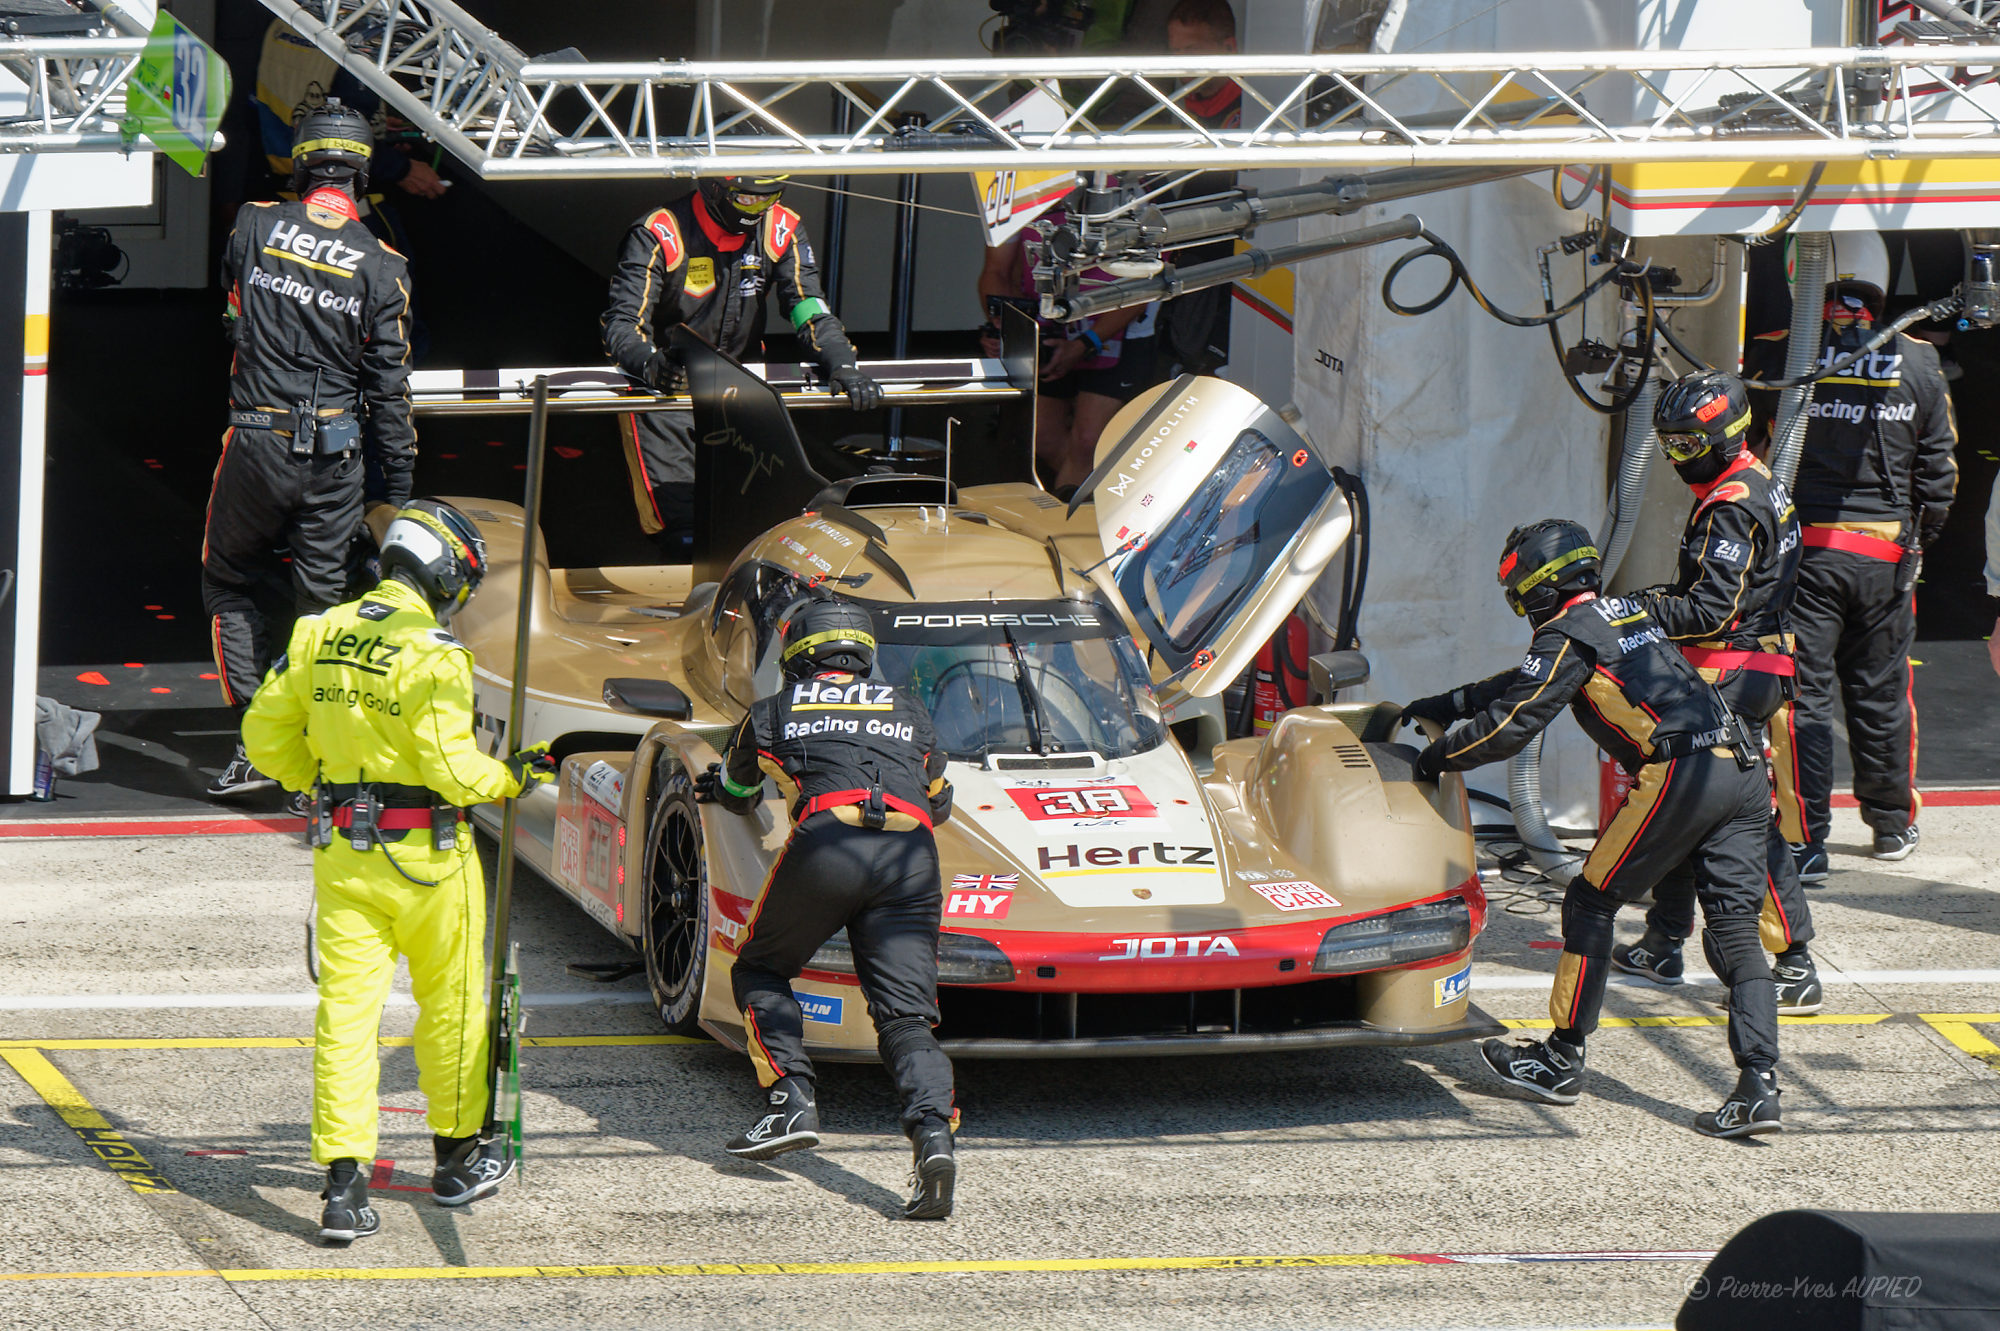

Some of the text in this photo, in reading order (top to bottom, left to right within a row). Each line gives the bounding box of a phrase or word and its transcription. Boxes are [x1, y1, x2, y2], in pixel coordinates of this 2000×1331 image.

[175, 33, 206, 149] 32
[265, 219, 367, 272] Hertz
[248, 265, 362, 318] Racing Gold
[1315, 348, 1345, 376] JOTA
[1808, 398, 1917, 424] acing Gold
[1129, 394, 1200, 472] MONOLITH
[893, 613, 1101, 628] PORSCHE
[319, 626, 402, 668] Hertz
[1617, 630, 1660, 655] Racing
[313, 683, 359, 708] acing
[792, 681, 894, 705] Hertz
[784, 715, 914, 742] Racing Gold
[1691, 725, 1732, 749] MRTC
[1034, 788, 1132, 816] 38
[561, 842, 579, 881] CAR
[1037, 842, 1217, 871] Hertz
[1256, 883, 1315, 895] HYPER
[1269, 890, 1334, 908] CAR
[947, 894, 1009, 914] HY
[1099, 936, 1240, 962] JOTA
